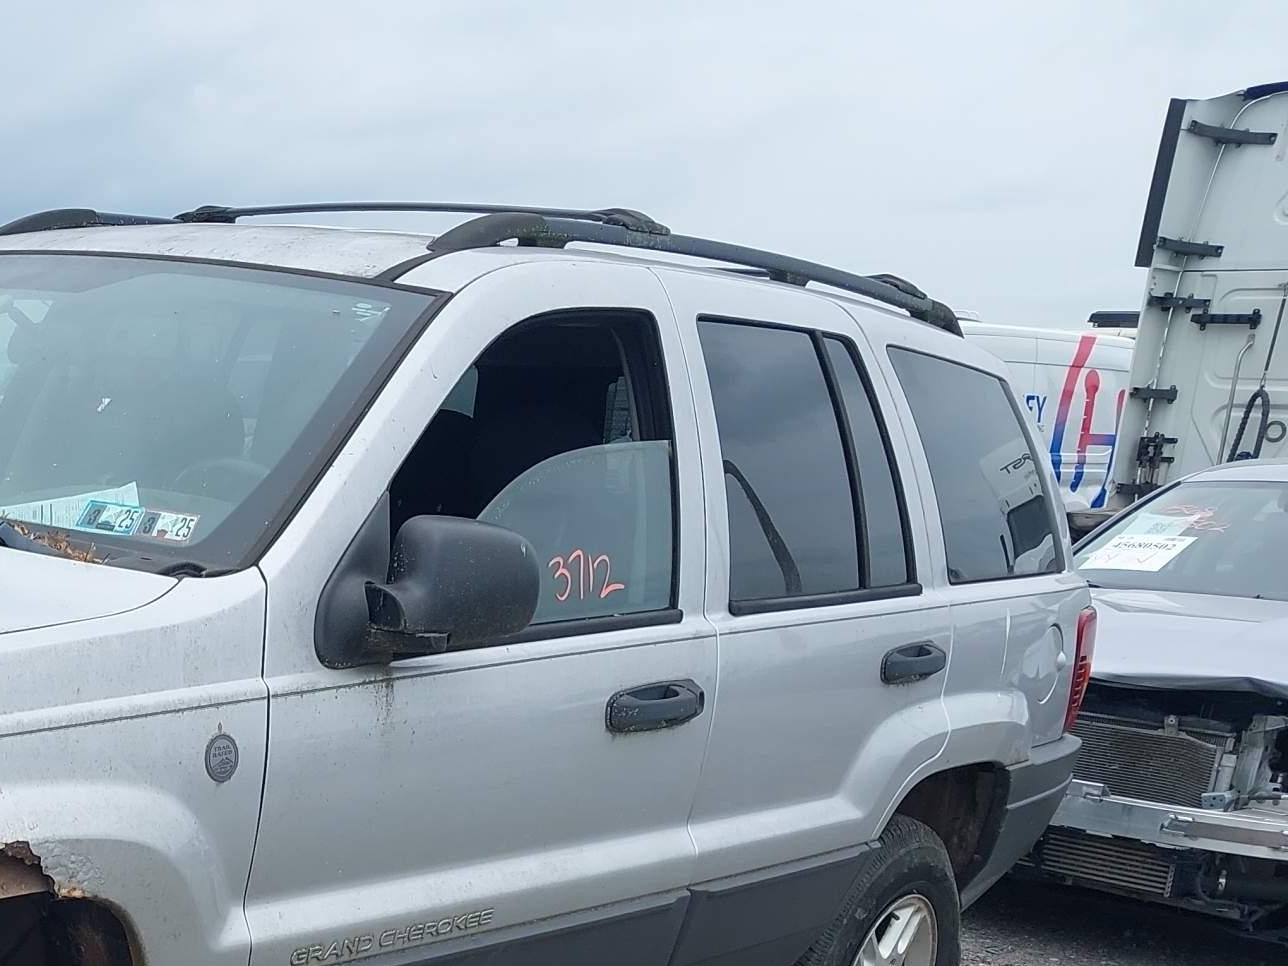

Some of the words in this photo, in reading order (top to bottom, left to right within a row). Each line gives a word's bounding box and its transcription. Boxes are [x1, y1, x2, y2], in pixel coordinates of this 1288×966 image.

[118, 509, 138, 529] 25
[175, 517, 195, 538] 25
[548, 549, 625, 601] 3712
[378, 907, 495, 947] CHEROKEE
